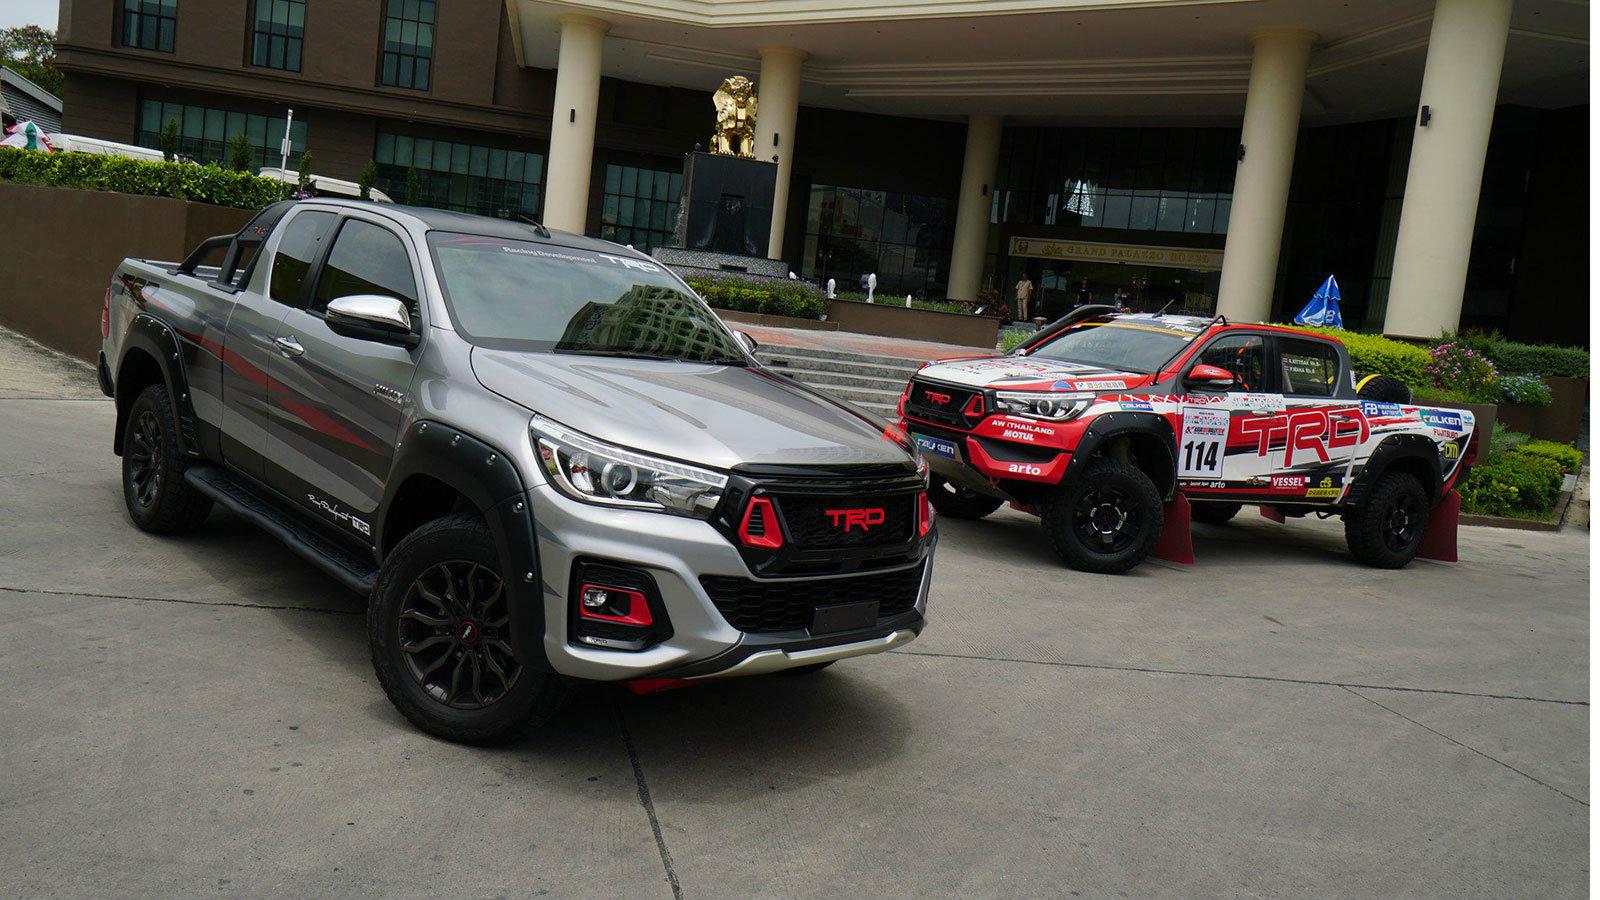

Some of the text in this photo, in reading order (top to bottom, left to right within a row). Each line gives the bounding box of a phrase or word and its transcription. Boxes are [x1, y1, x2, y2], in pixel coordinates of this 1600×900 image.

[1067, 245, 1209, 264] GRAND PALAZZO HOTEL
[599, 254, 660, 273] TRD
[1166, 322, 1201, 332] TRD
[925, 390, 951, 405] TRD
[1120, 403, 1152, 411] FALKEN
[1364, 402, 1377, 415] FB
[992, 420, 1006, 428] AW
[1423, 414, 1462, 426] FALKEN
[1003, 429, 1034, 441] MOTUL
[1241, 408, 1371, 469] TRD
[916, 438, 955, 454] FALKEN
[1184, 441, 1219, 471] 114
[1008, 464, 1041, 476] arto
[1210, 480, 1226, 489] arto
[1273, 477, 1303, 487] VESSEL
[825, 508, 885, 532] TRD
